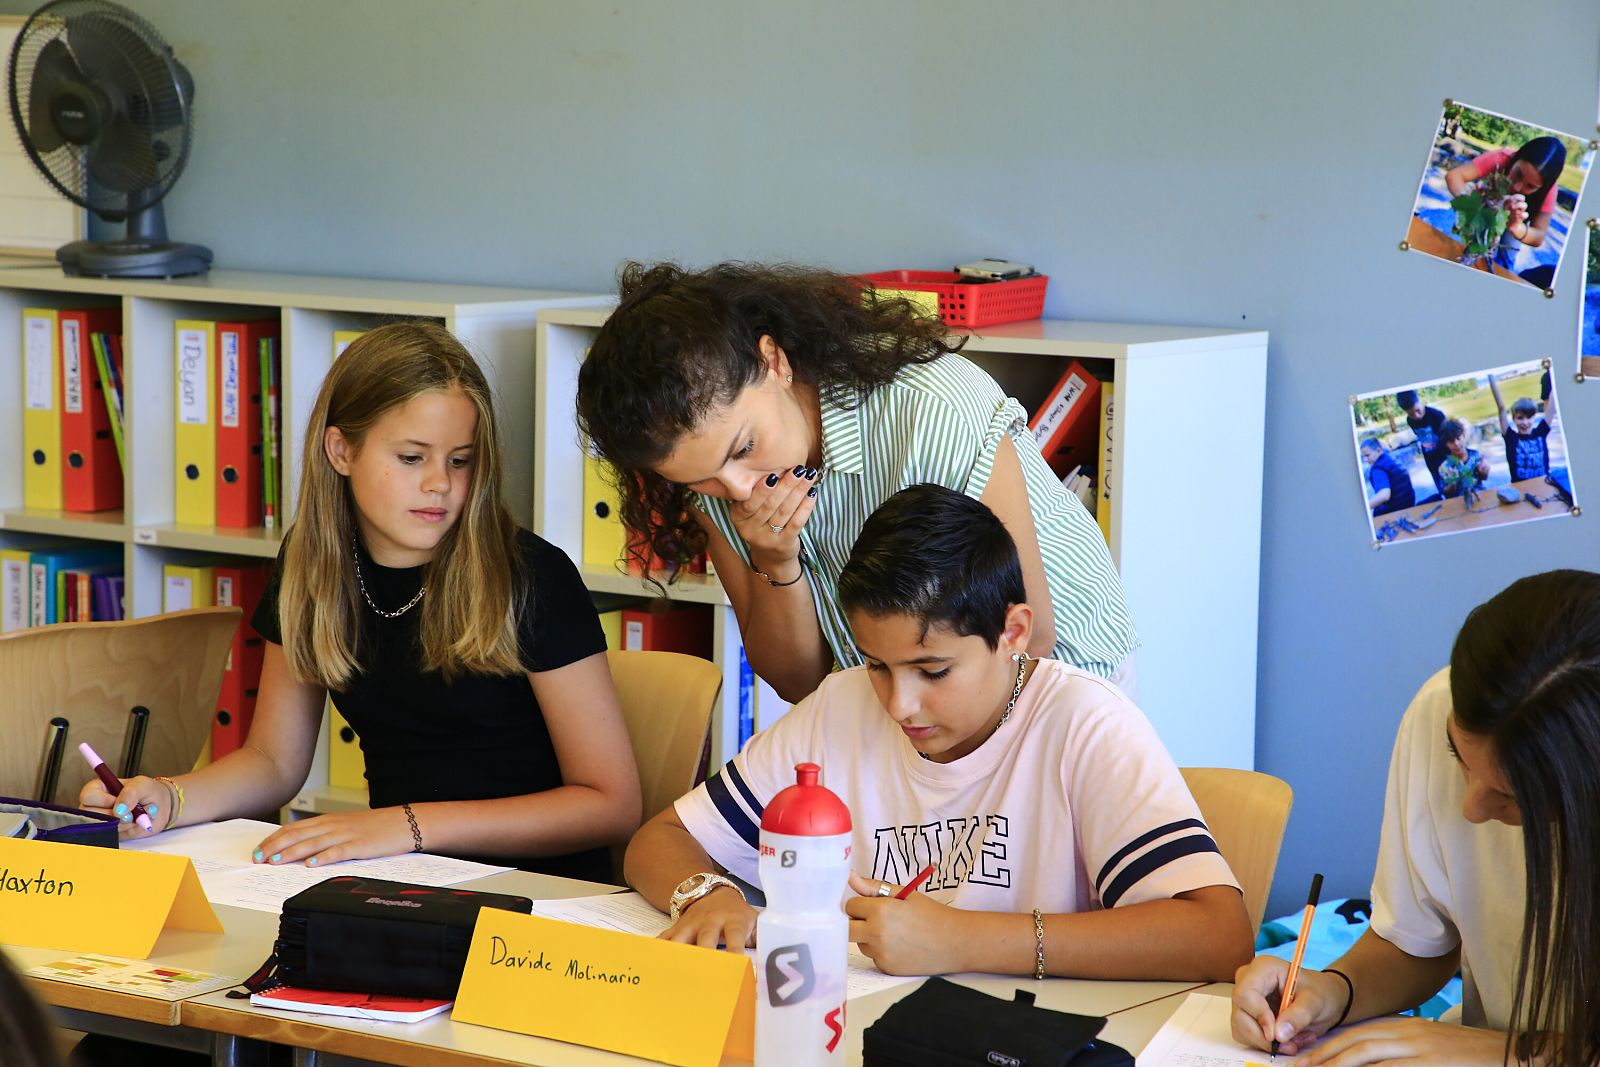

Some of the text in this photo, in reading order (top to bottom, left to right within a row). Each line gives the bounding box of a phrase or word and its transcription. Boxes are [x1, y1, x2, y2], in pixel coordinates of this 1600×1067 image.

[872, 815, 1010, 893] NIKE
[490, 936, 641, 985] Davide Molinario
